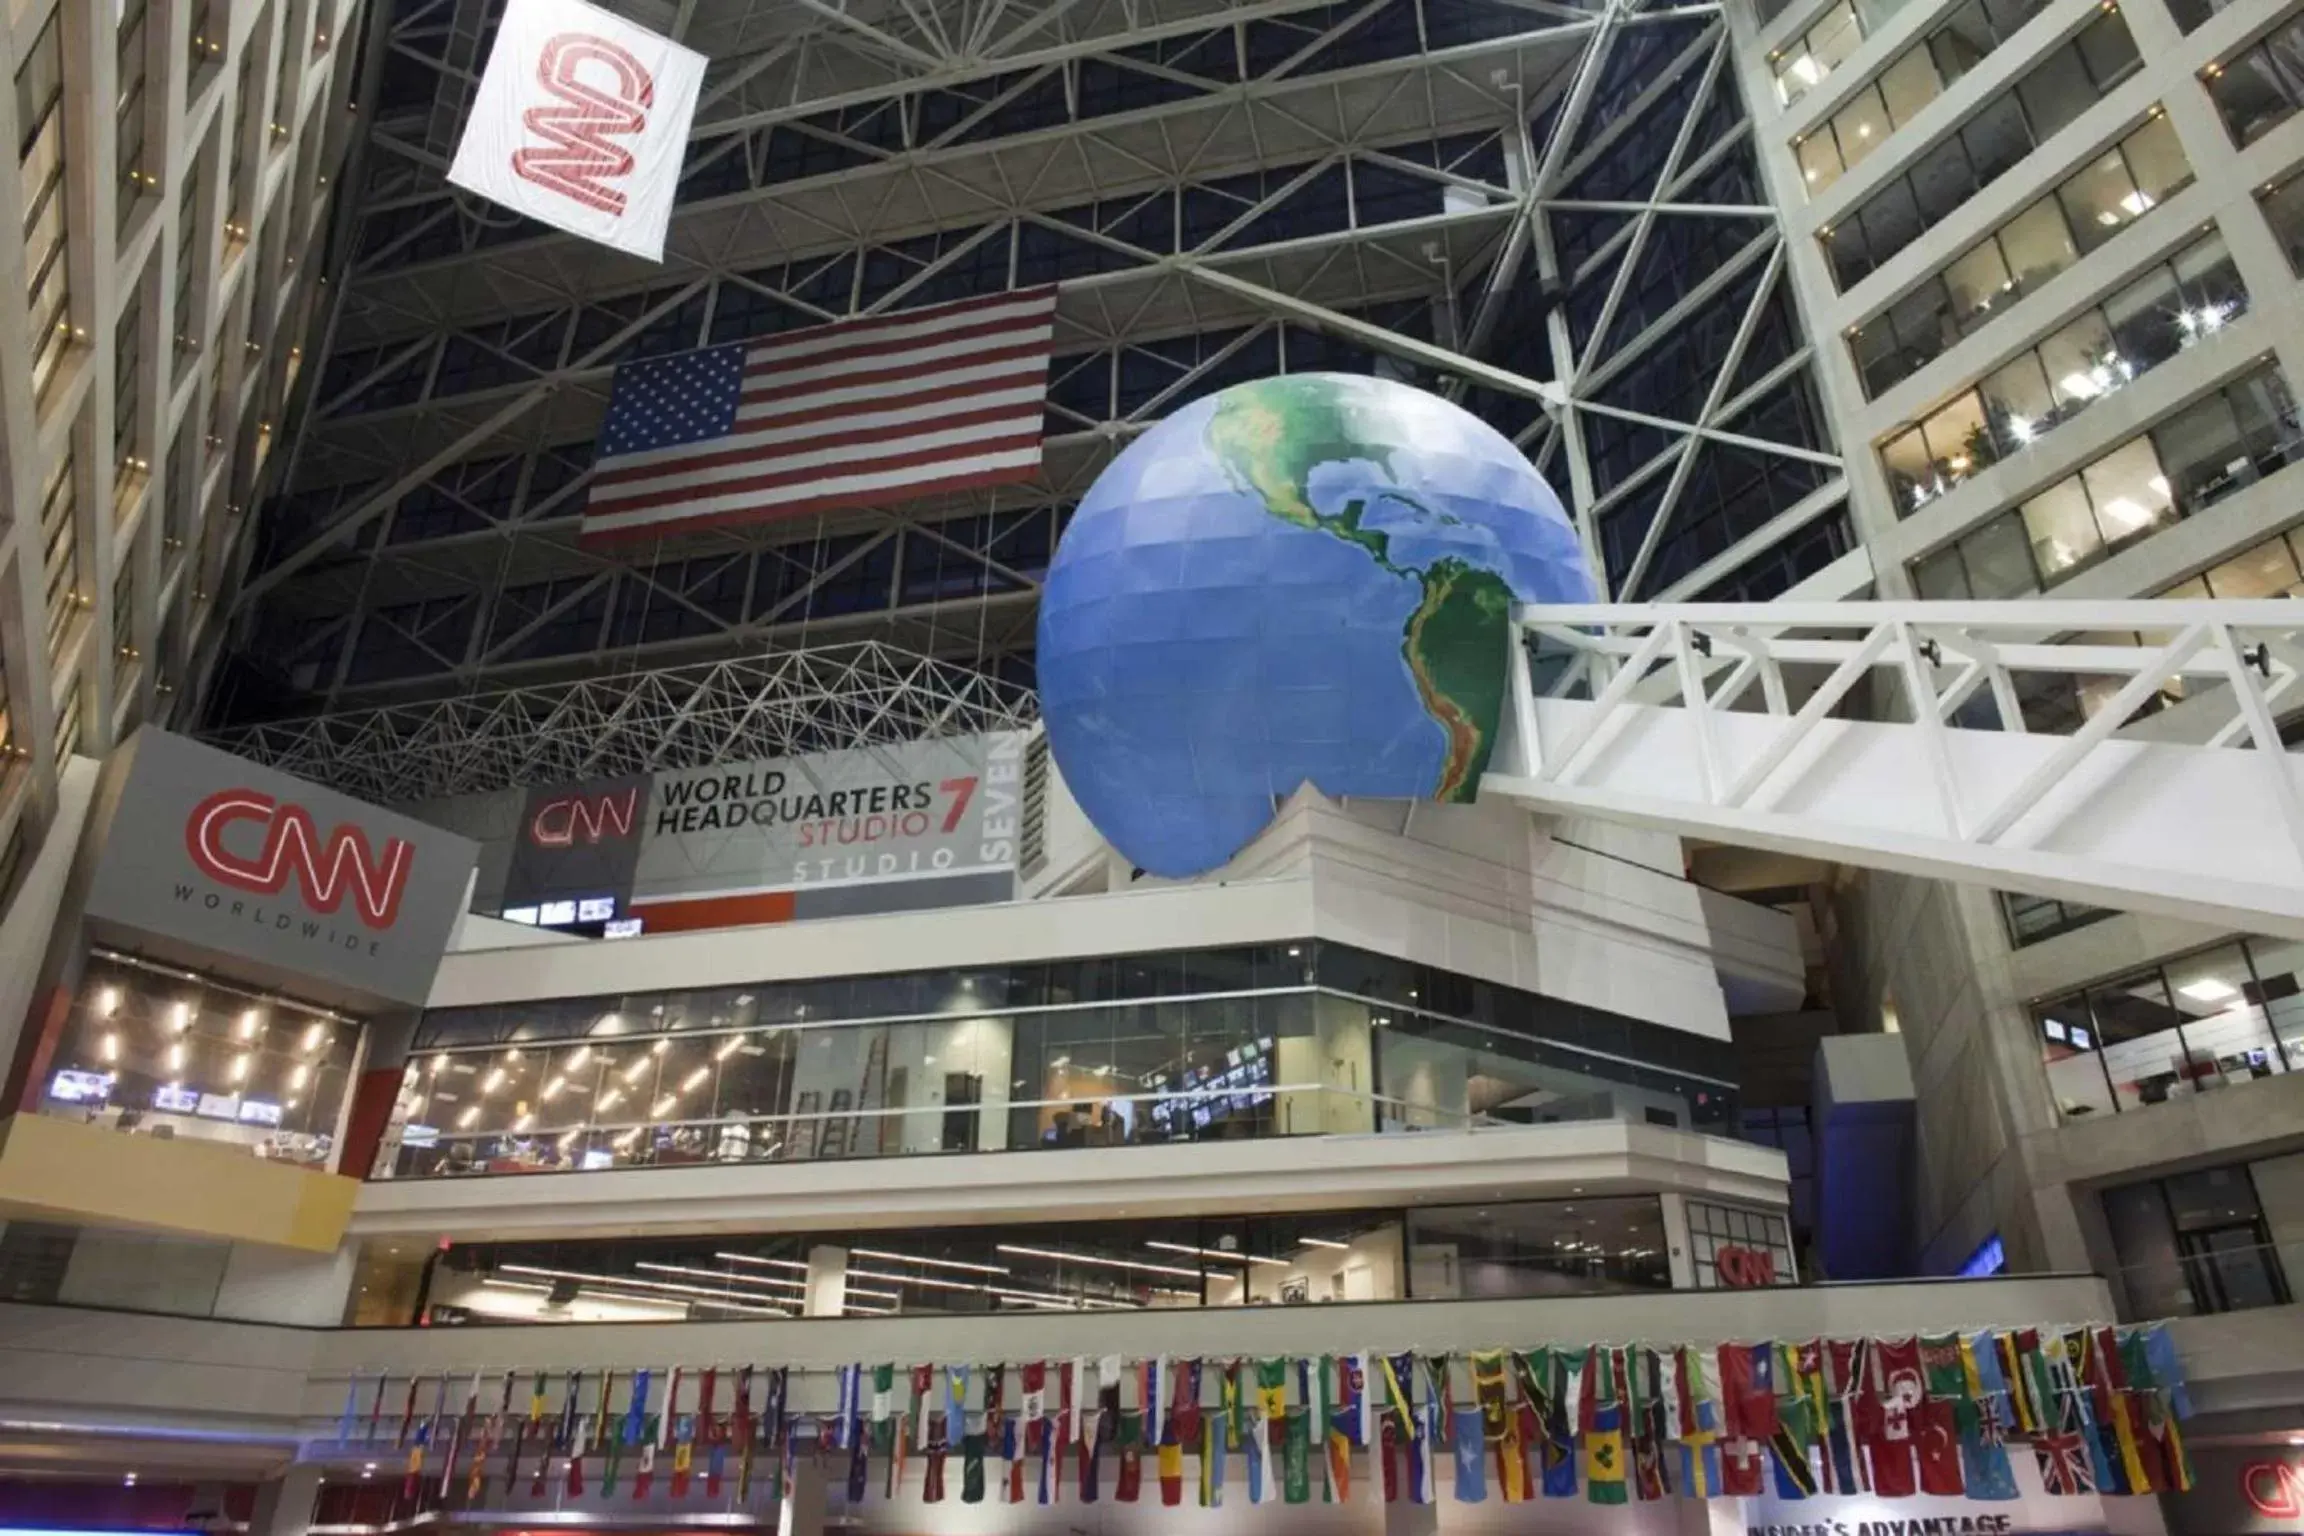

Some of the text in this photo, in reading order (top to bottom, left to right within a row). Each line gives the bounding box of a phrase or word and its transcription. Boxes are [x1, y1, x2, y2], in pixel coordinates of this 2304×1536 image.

[511, 33, 653, 216] CNN
[531, 787, 637, 846] CNN
[655, 781, 932, 836] HEADQUARTERS
[663, 771, 786, 807] WORLD
[799, 776, 979, 847] STUDIO 7
[980, 732, 1022, 862] SEVEN
[186, 788, 416, 931] CNN
[793, 848, 954, 883] STUDIO
[174, 885, 381, 957] WORLDWIDE
[1717, 1245, 1776, 1288] CNN
[1857, 1514, 2011, 1536] ADVANTAGE
